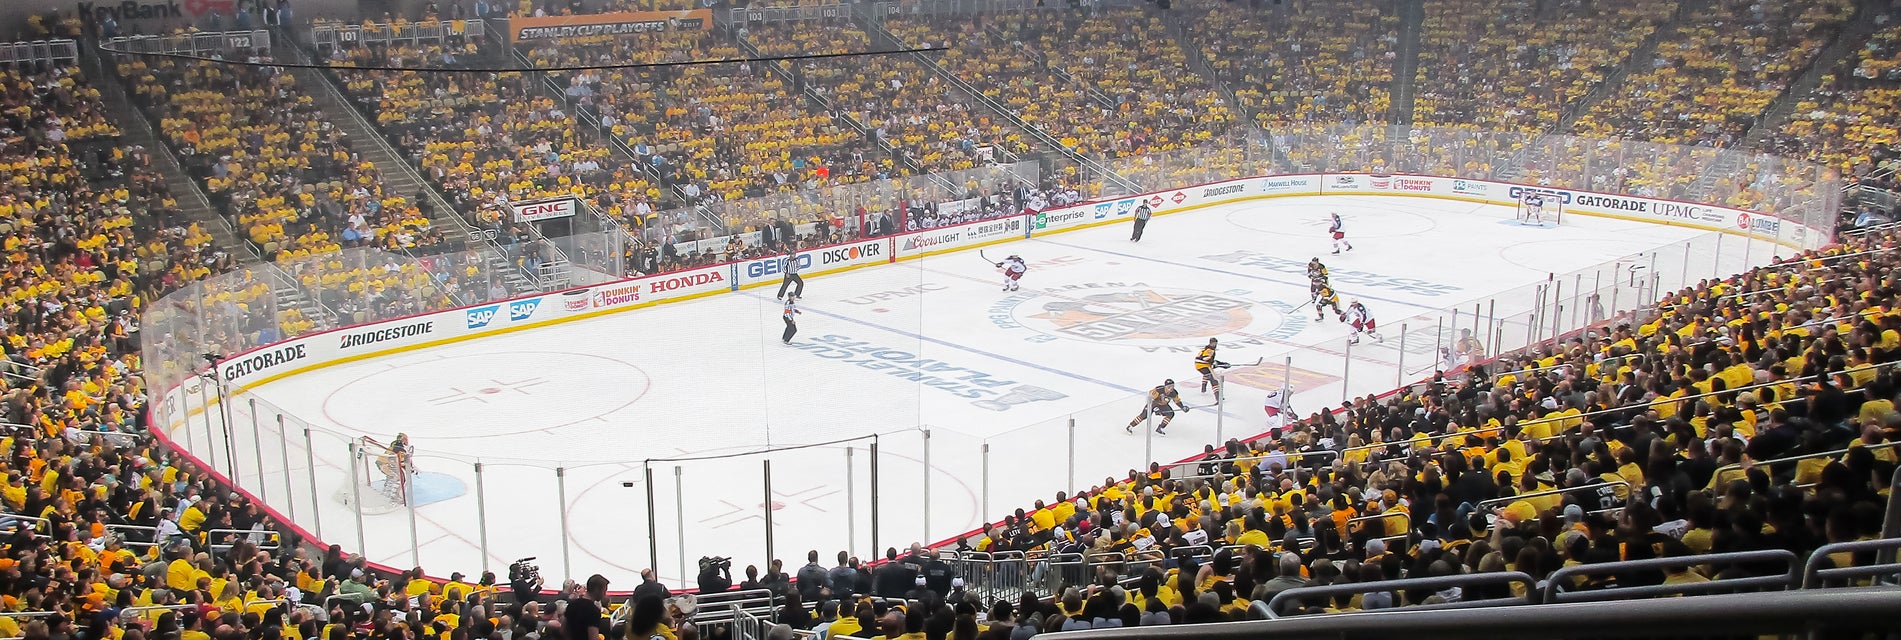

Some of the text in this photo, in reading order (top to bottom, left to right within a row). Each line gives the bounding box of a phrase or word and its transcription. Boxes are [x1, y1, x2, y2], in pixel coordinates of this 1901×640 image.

[750, 13, 762, 21] 103
[339, 32, 357, 41] 101
[520, 27, 576, 40] STANLEY
[577, 24, 602, 36] CUP
[603, 21, 665, 35] PLAYOFFS
[230, 38, 250, 47] 122
[1203, 183, 1245, 198] BRIDGESTONE
[1467, 183, 1487, 191] PAINTS
[1509, 186, 1572, 204] GCO
[522, 202, 568, 216] GNC
[1095, 205, 1110, 217] SAP
[1117, 202, 1131, 213] SAP
[1577, 195, 1647, 212] GATORADE
[1652, 202, 1700, 220] UPMC
[1038, 209, 1085, 226] enterprise
[1751, 217, 1780, 232] LUMBE
[912, 235, 939, 249] Coors
[939, 232, 960, 244] LIGHT
[823, 243, 880, 265] DISCOVER
[748, 253, 812, 278] GEIO
[650, 271, 725, 294] HONDA
[605, 285, 641, 298] DUNKIN'
[606, 293, 640, 306] DONUTS
[839, 282, 949, 306] UPMC
[468, 310, 493, 326] SAP
[511, 302, 536, 318] SAP
[340, 321, 433, 349] BRIDGESTONE
[225, 343, 306, 382] GATORADE
[809, 334, 1017, 389] PLAYOFFS
[841, 358, 999, 399] STANLEY
